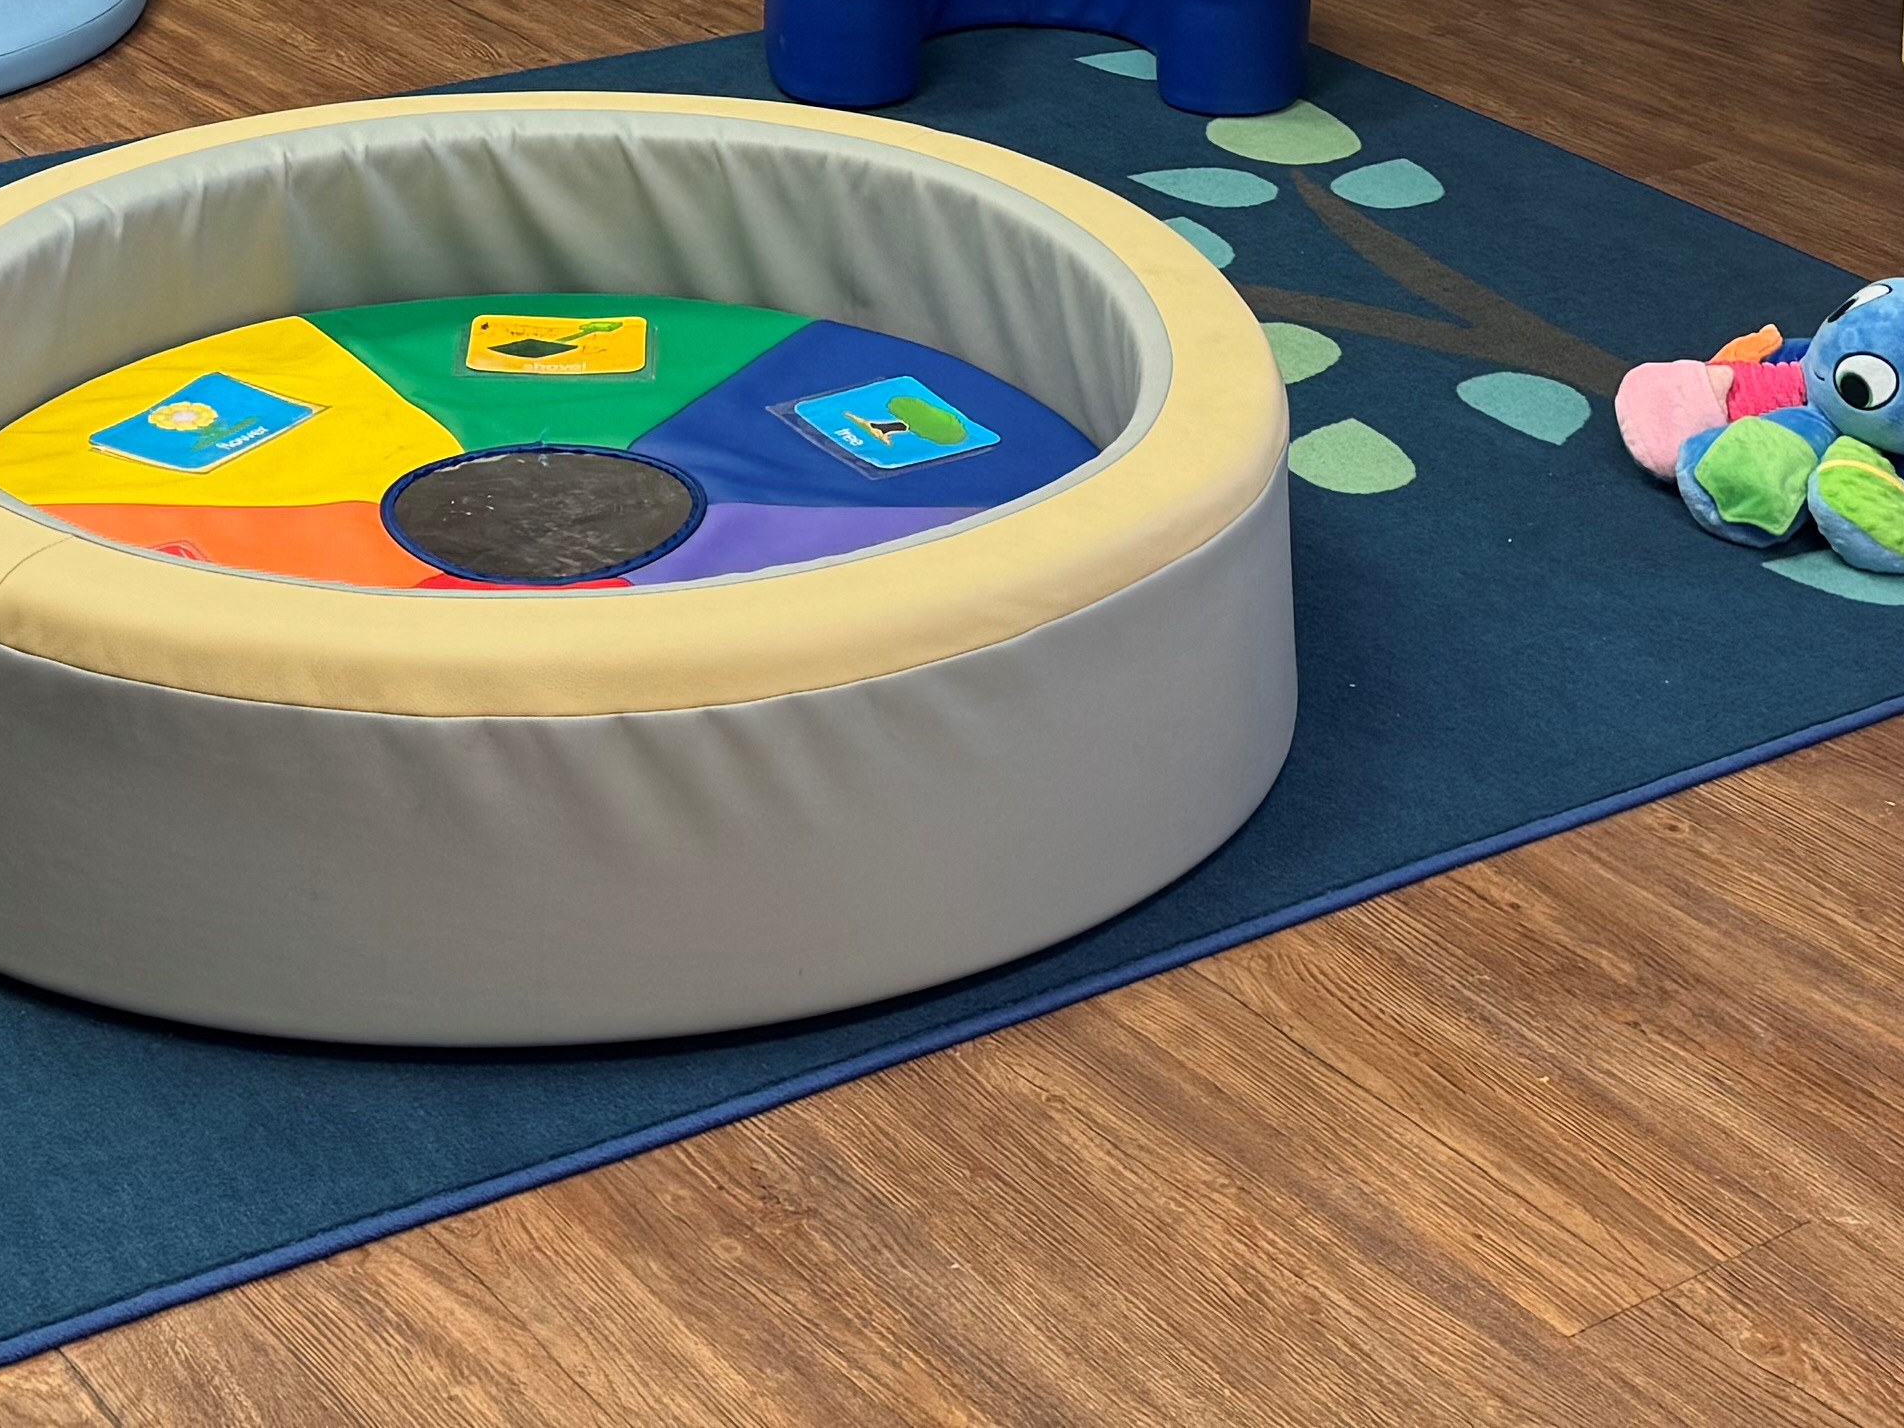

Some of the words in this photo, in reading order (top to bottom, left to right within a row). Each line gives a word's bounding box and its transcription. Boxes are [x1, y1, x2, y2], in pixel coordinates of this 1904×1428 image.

[523, 361, 587, 372] shovel
[215, 426, 269, 450] flower
[834, 428, 865, 447] tree
